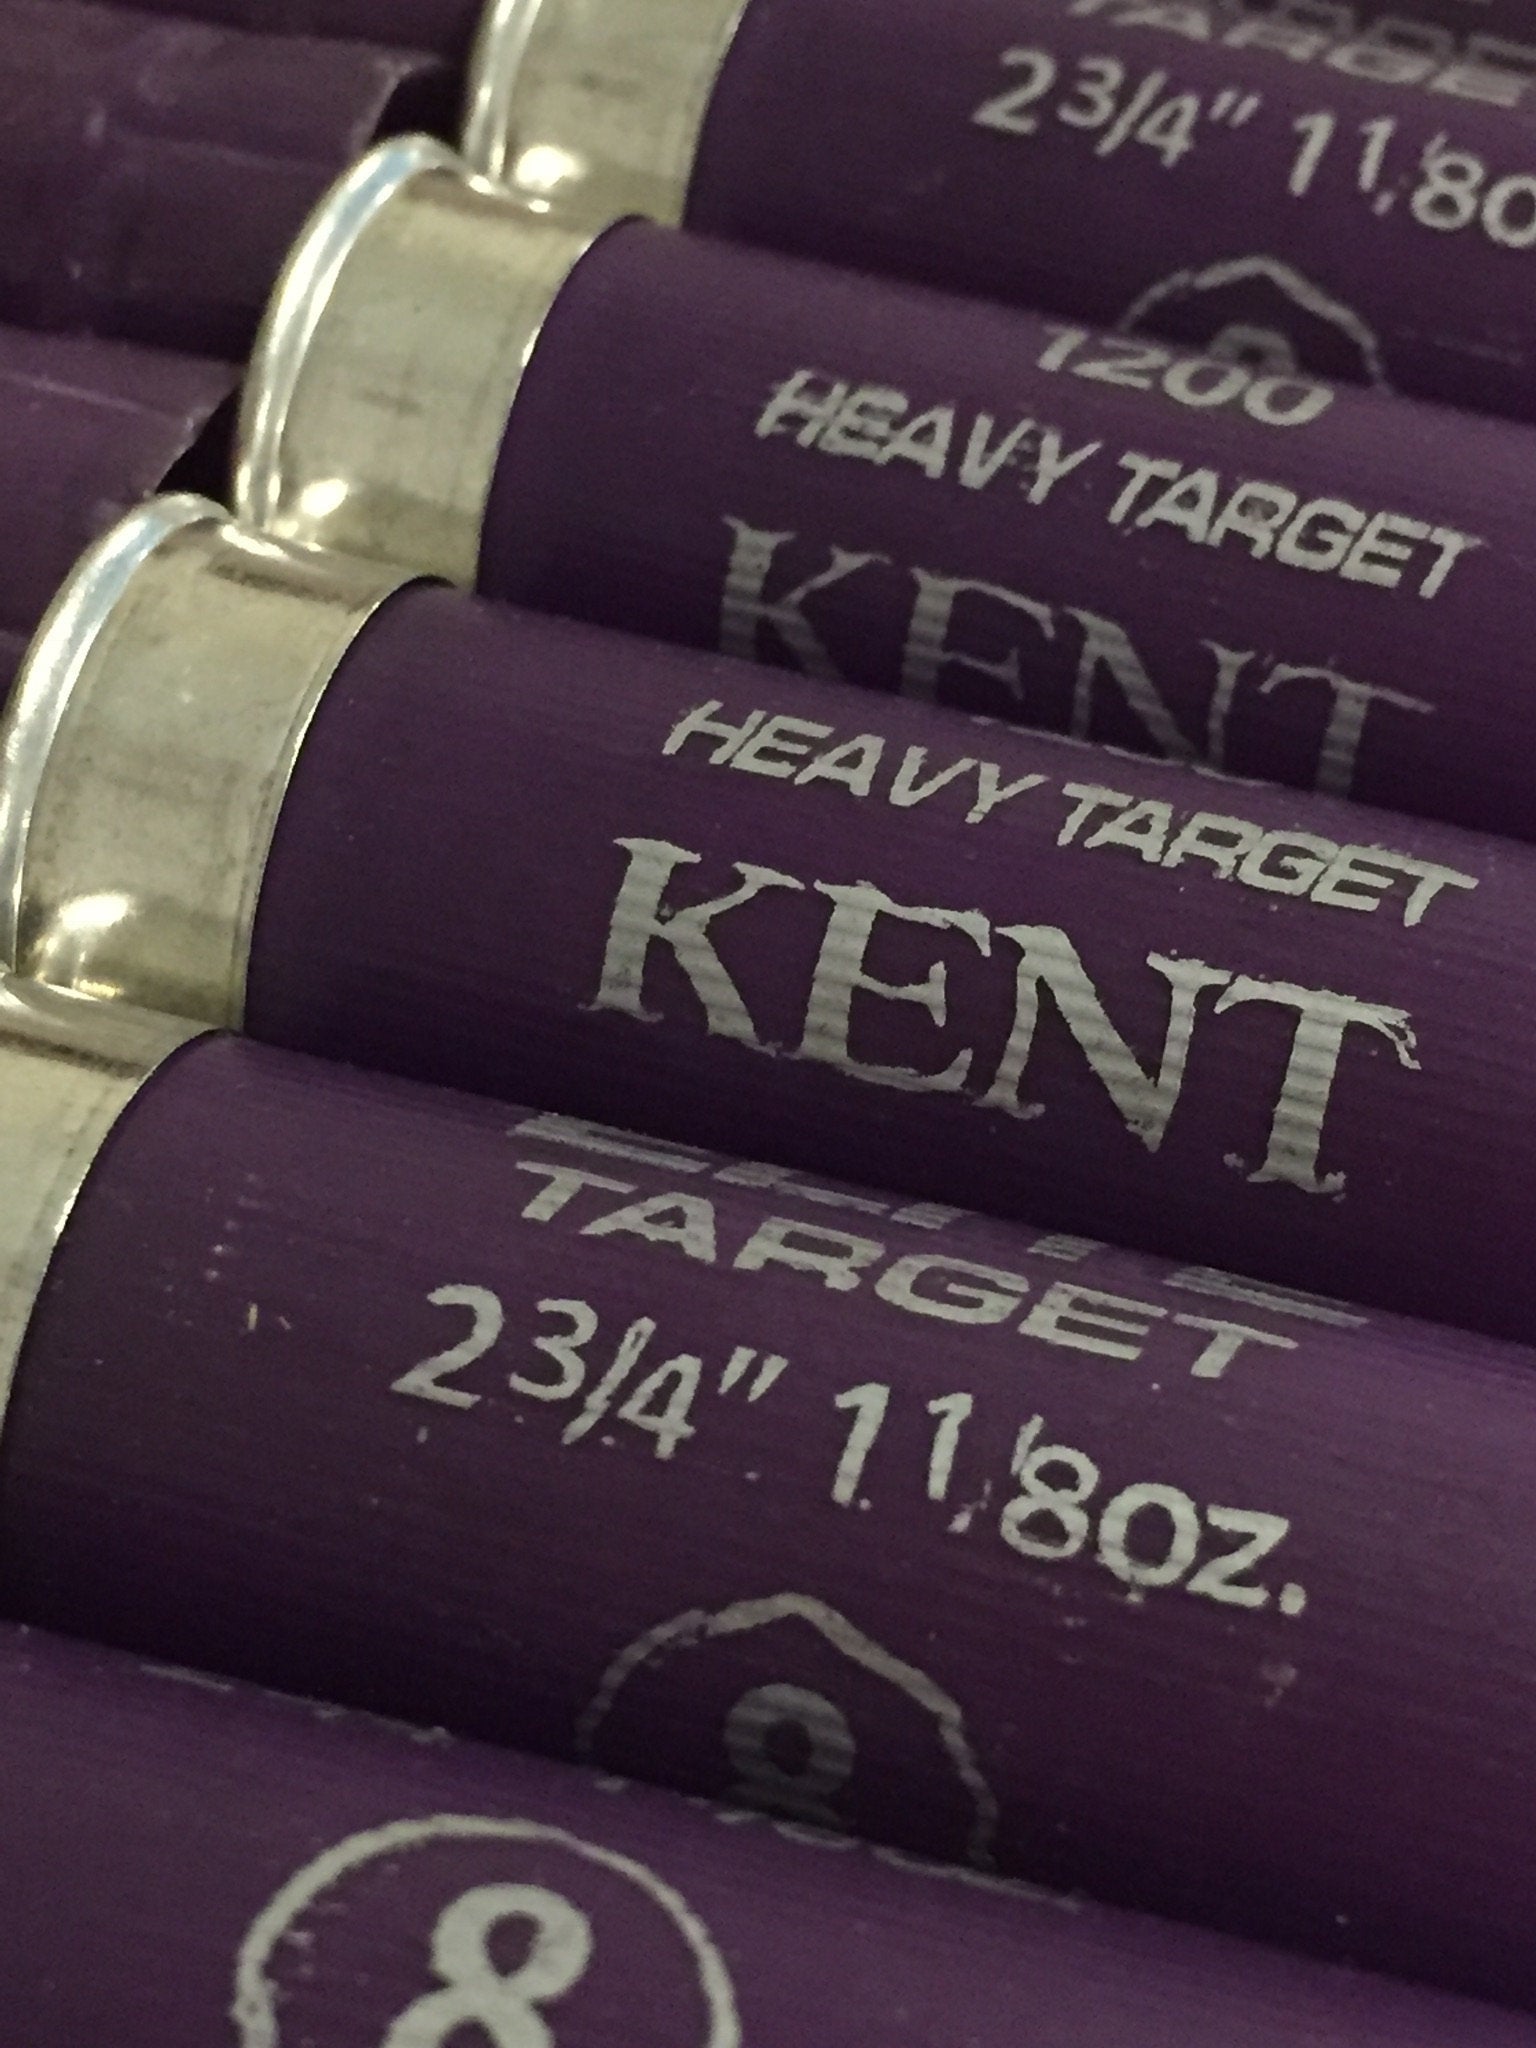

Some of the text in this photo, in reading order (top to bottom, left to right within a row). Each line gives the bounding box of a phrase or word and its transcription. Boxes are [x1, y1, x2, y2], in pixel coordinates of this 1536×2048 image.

[756, 369, 1486, 601] HEAVY TARGET
[1037, 322, 1335, 427] 1200
[719, 515, 1436, 801] KENT
[661, 700, 1479, 927] HEAVY TARGET
[588, 836, 1422, 1197] KENT
[516, 1160, 1300, 1379] TARGET
